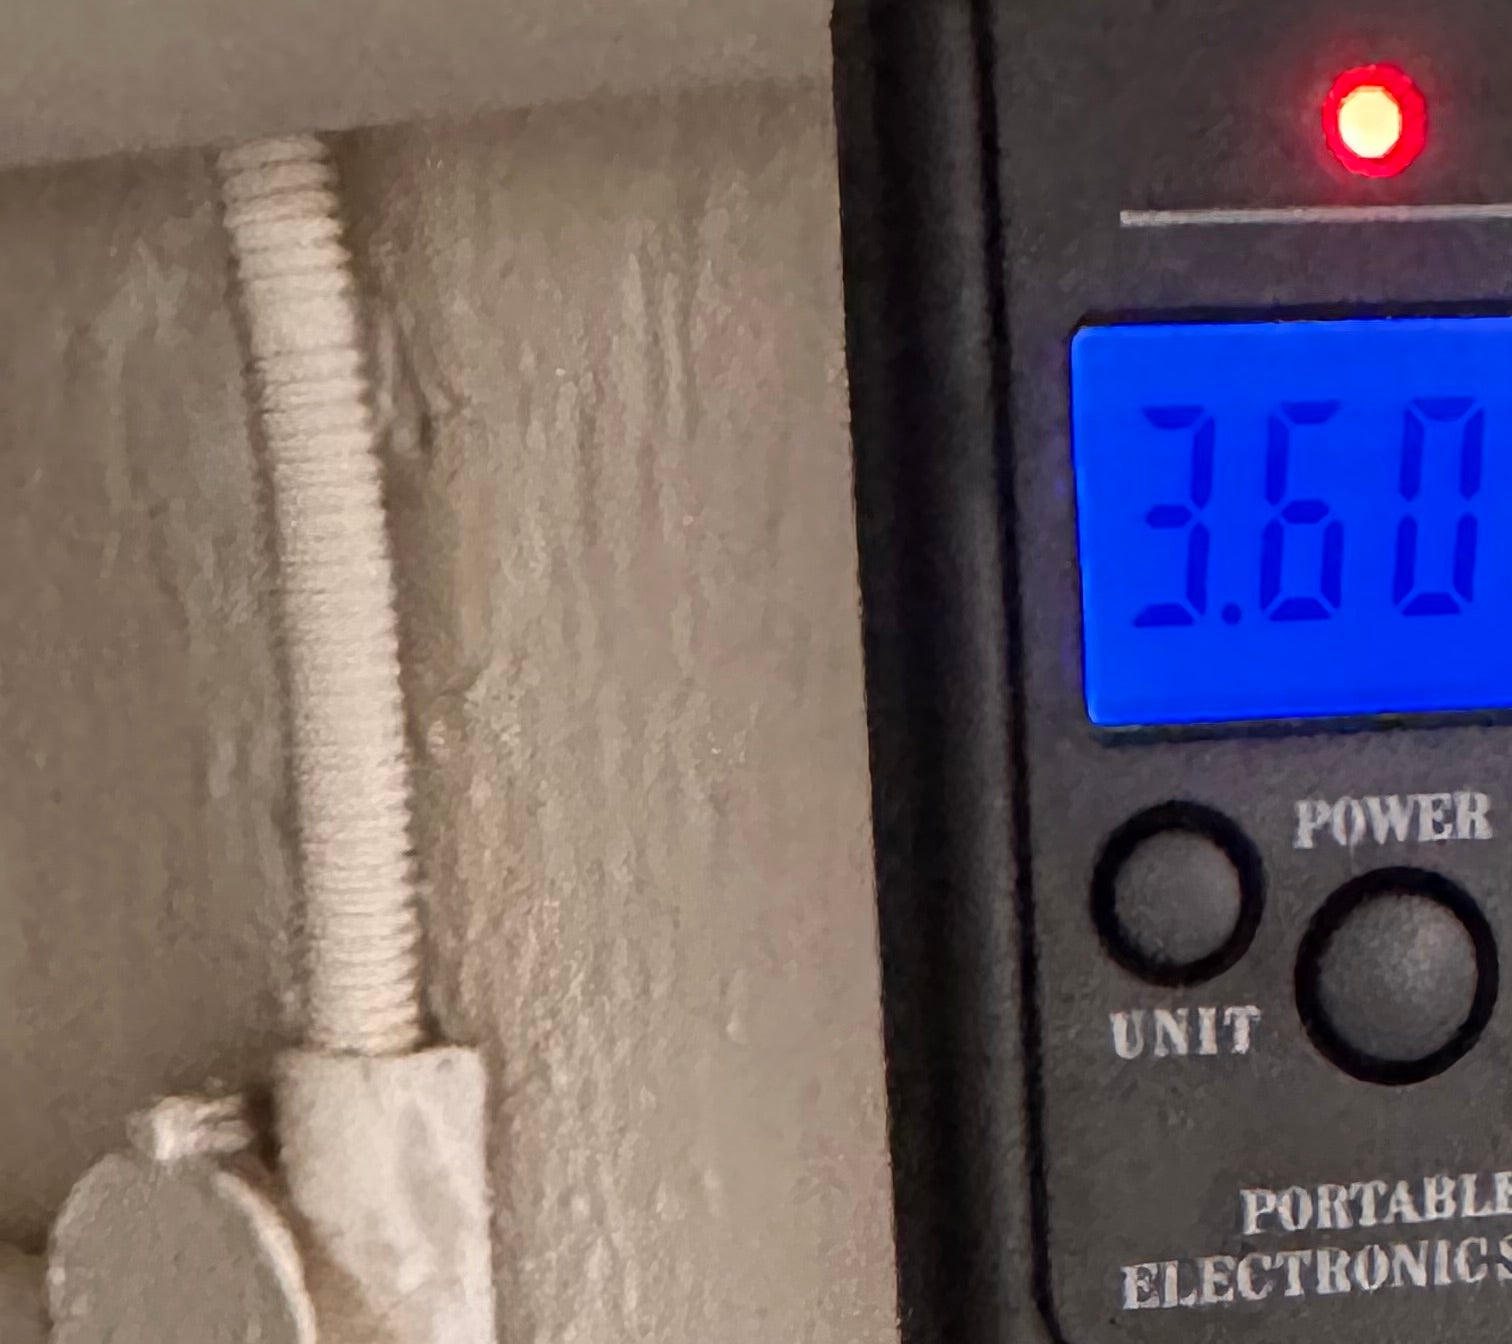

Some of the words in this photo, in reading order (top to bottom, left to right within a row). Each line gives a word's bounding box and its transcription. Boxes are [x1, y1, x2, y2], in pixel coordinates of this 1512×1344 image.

[1293, 791, 1493, 849] POWER
[1109, 1005, 1261, 1060] UNIT
[1121, 1235, 1488, 1310] ELECTRONIC
